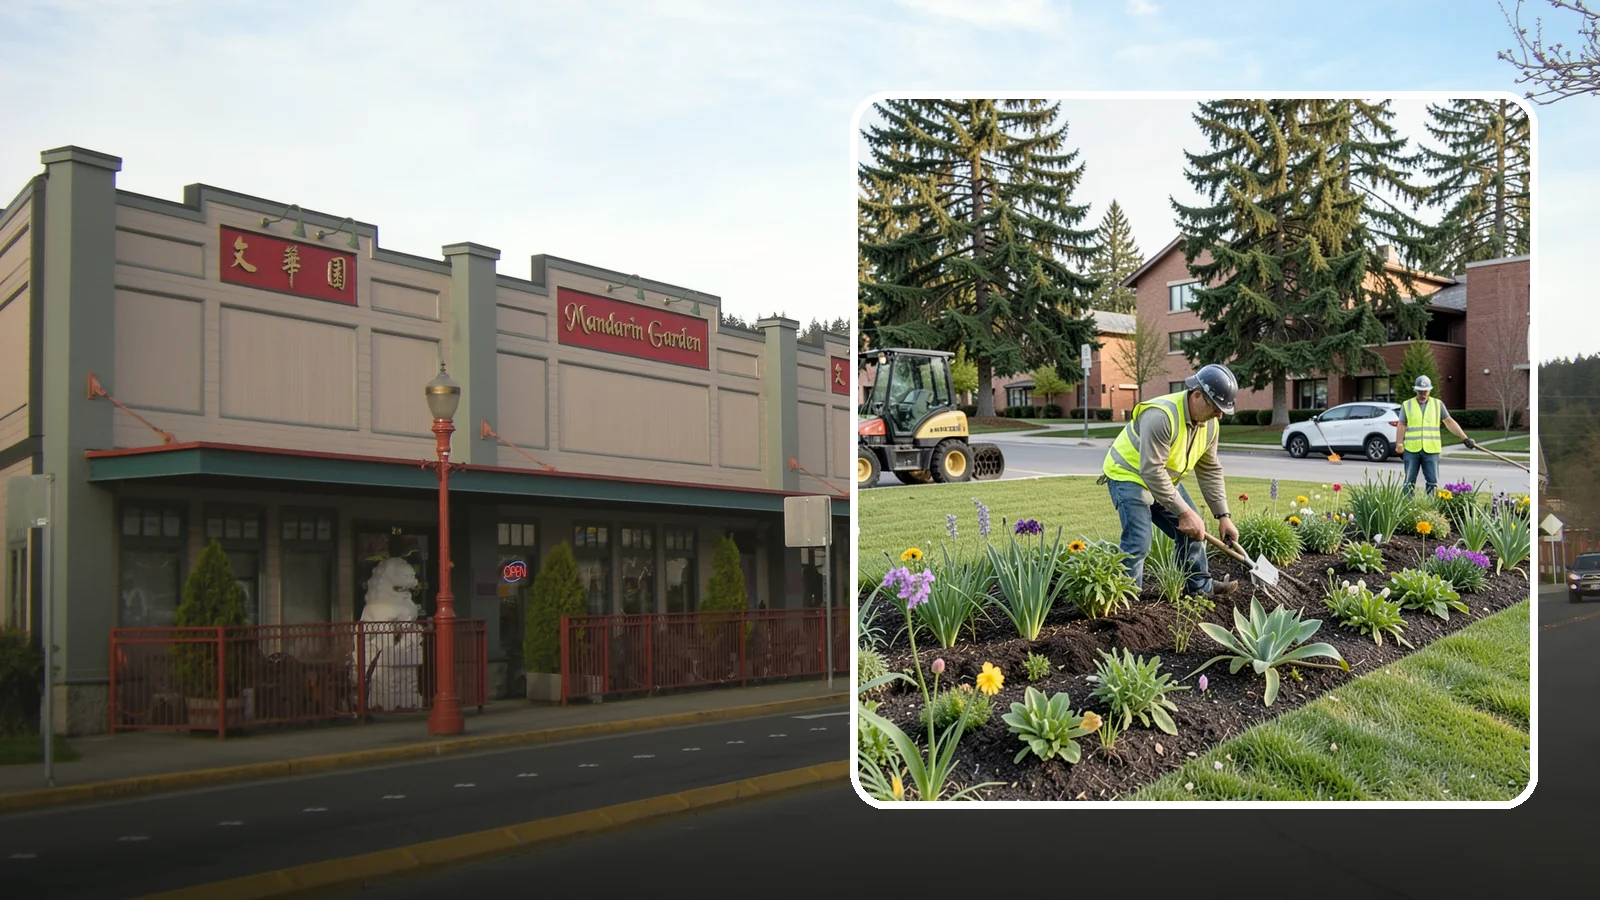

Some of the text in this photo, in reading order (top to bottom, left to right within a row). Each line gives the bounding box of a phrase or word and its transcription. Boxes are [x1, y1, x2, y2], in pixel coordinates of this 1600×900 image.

[230, 235, 346, 291] 文華園
[564, 302, 702, 352] Mandarin Garden
[503, 565, 527, 578] OPEN
